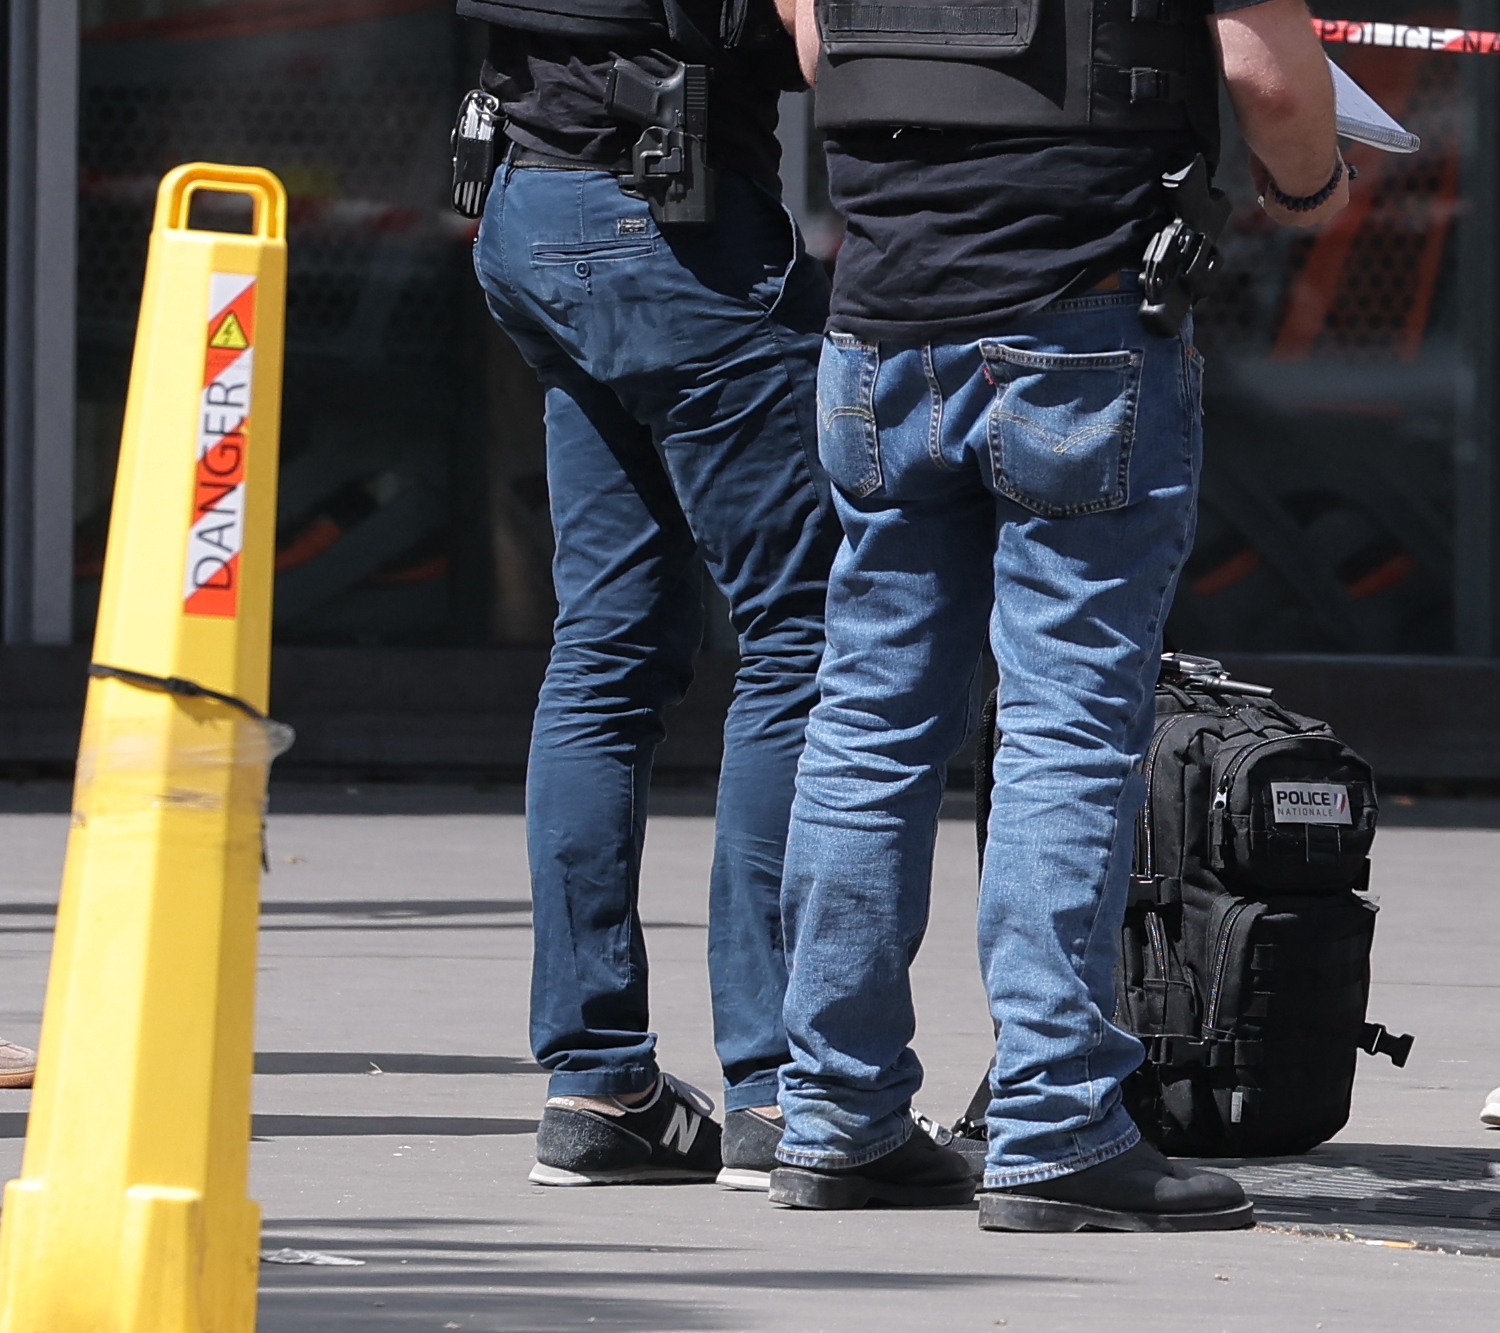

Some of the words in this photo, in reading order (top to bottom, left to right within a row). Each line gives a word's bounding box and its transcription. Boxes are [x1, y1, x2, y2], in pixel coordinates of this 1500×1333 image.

[192, 379, 247, 590] DANGER
[1275, 790, 1332, 806] POLICE
[1276, 806, 1334, 818] NATIONALE
